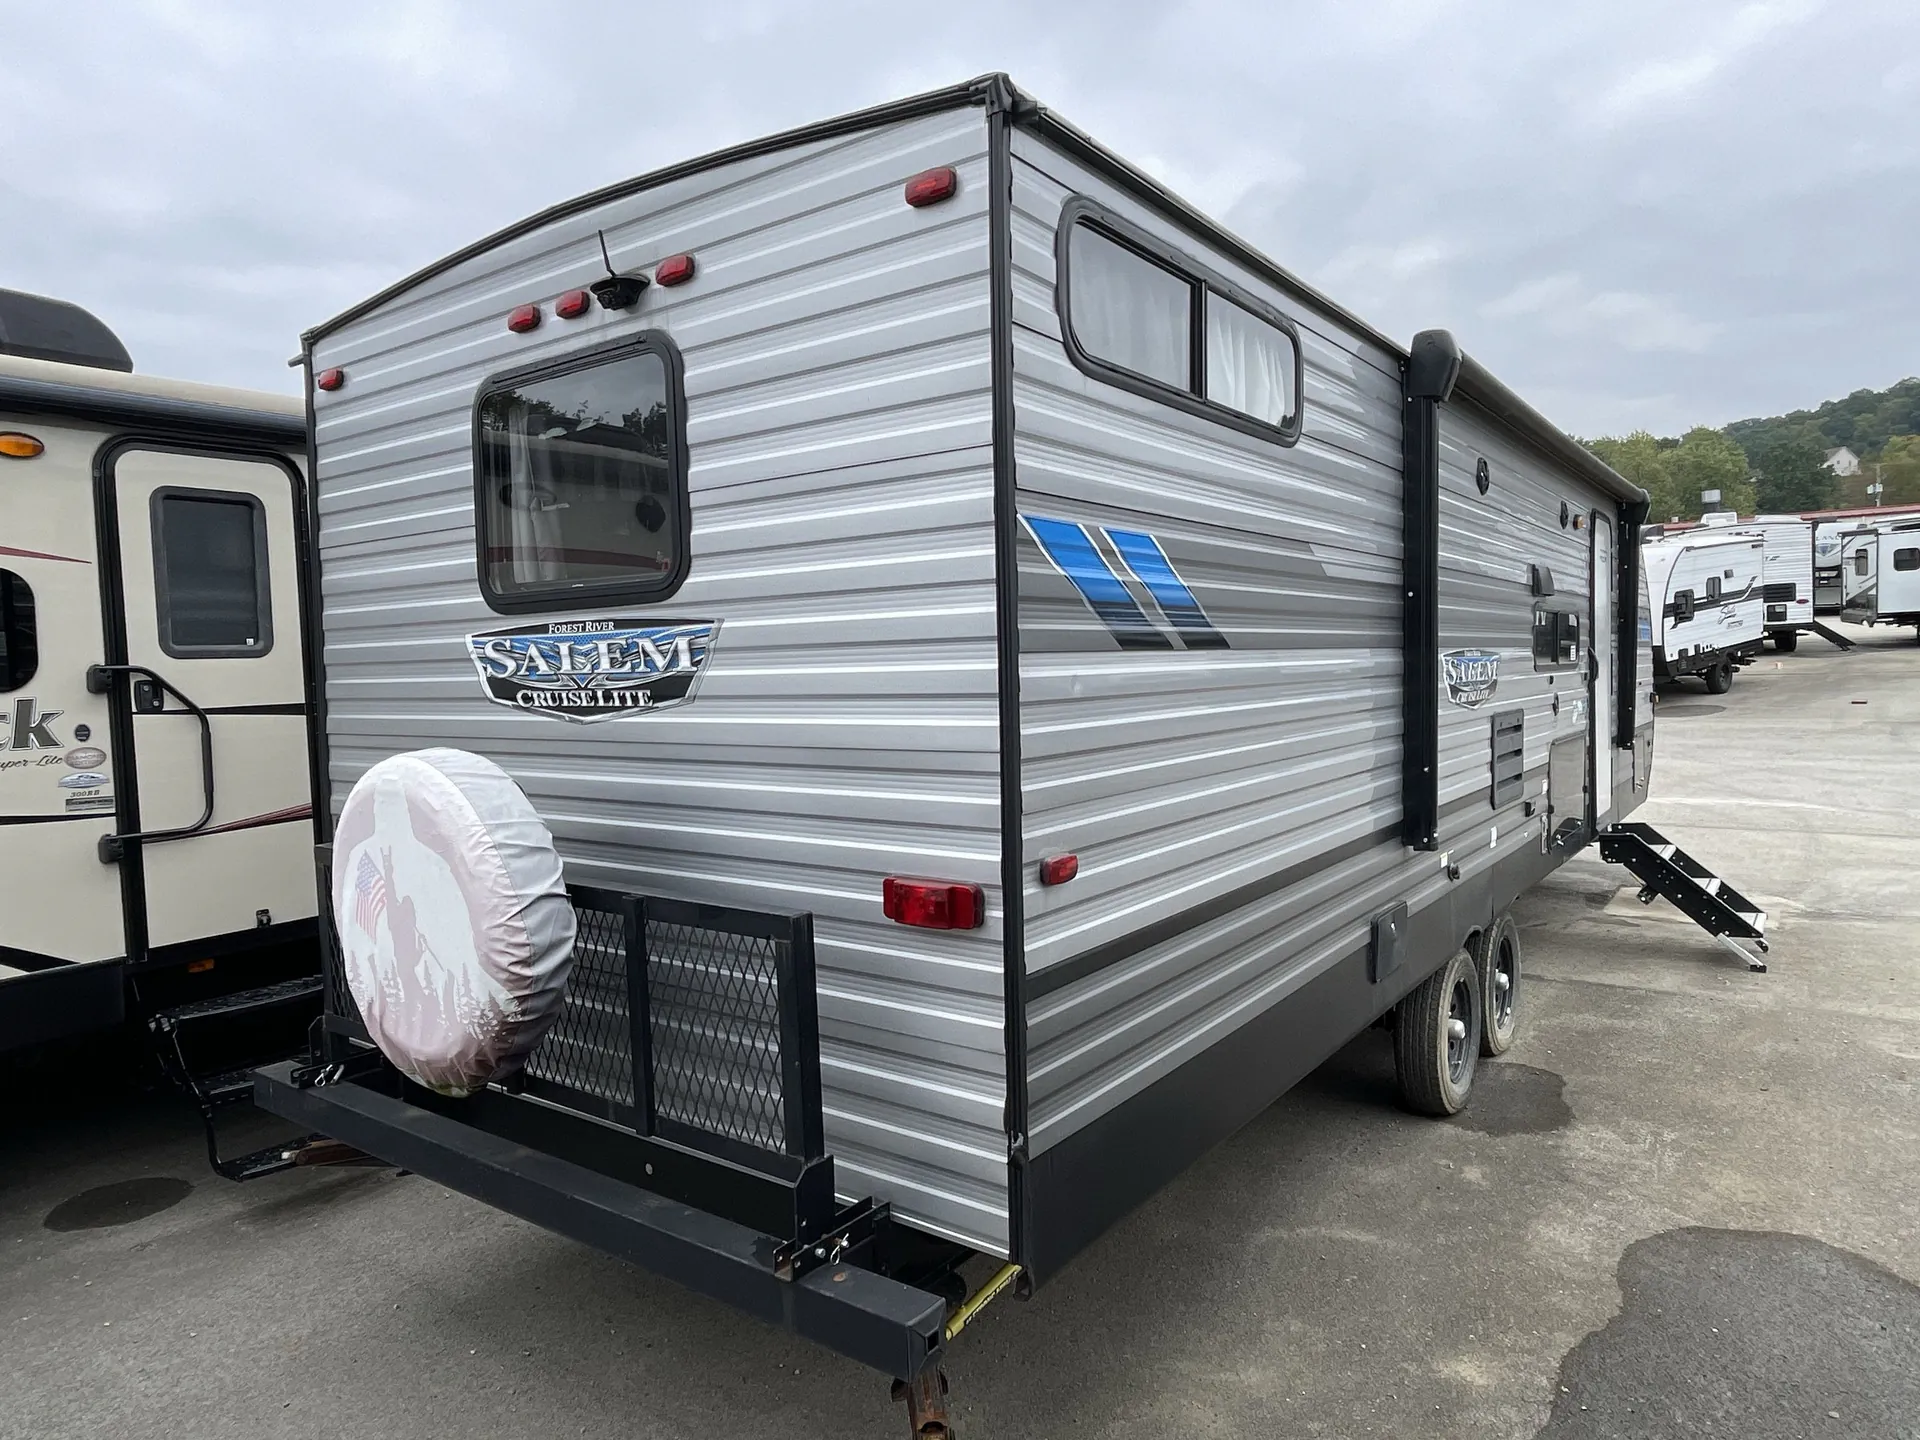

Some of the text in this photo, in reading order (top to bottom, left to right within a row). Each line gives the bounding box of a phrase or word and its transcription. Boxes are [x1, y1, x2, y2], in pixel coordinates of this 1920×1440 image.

[549, 621, 615, 635] FOREST RIVER
[483, 635, 698, 677] SALEM
[1447, 659, 1499, 684] SALEM
